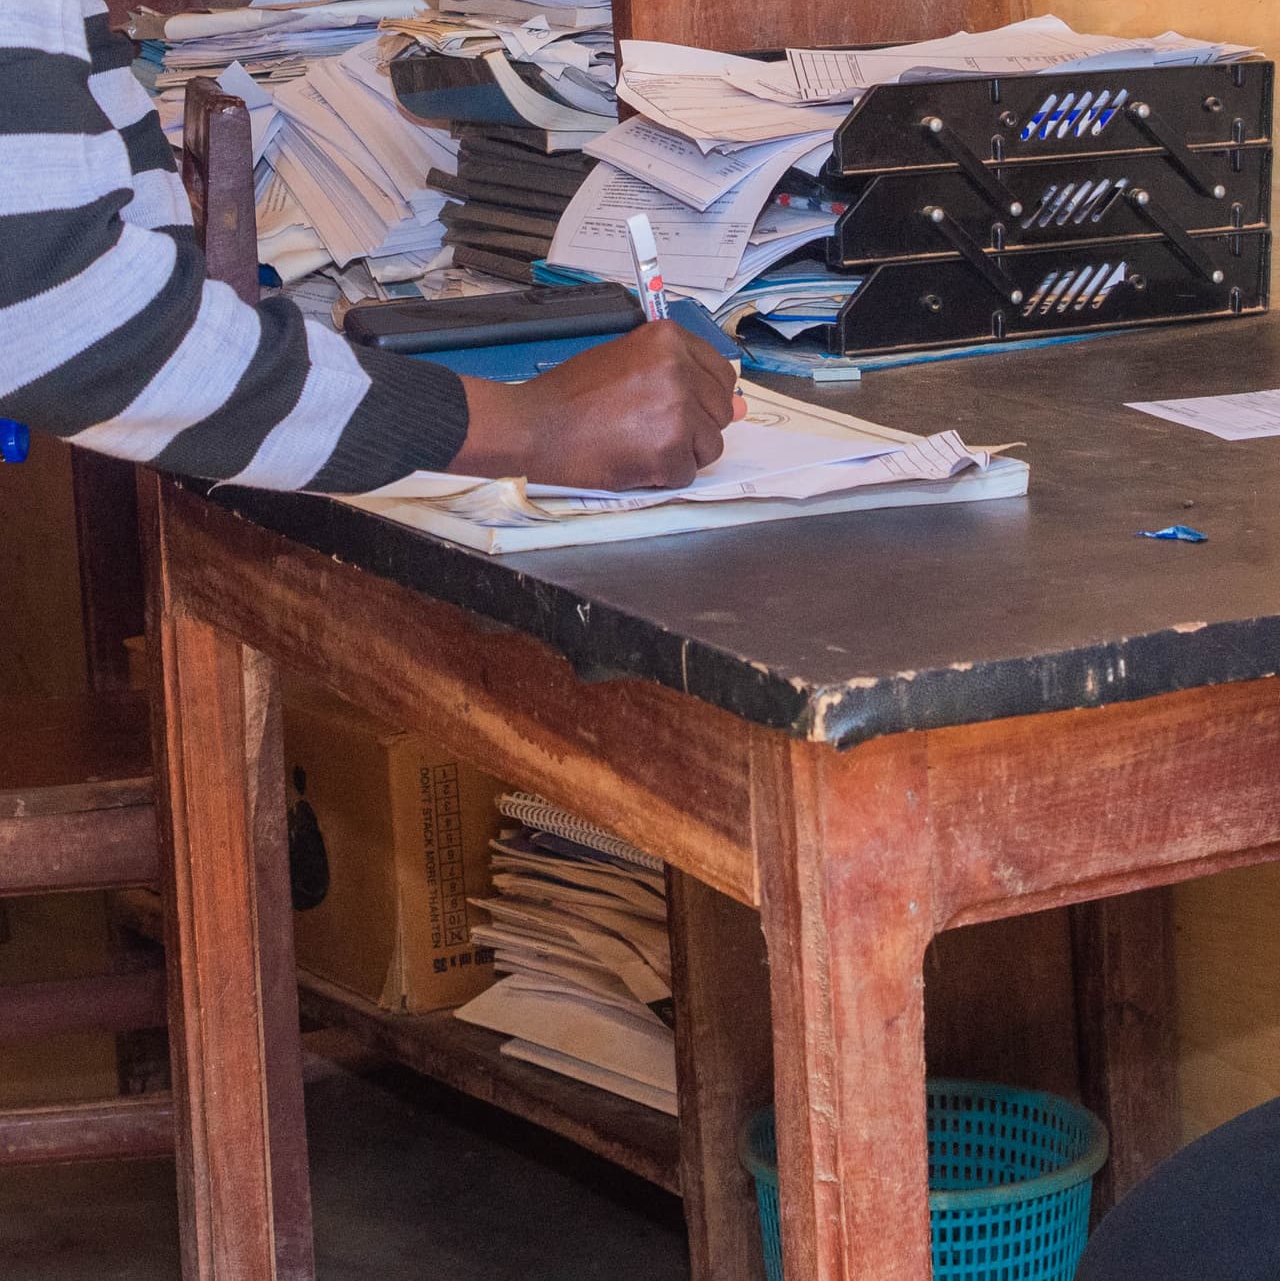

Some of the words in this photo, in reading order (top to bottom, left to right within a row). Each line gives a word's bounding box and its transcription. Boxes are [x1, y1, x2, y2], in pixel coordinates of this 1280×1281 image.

[422, 807, 436, 848] STACK
[424, 850, 439, 887] MORE
[428, 890, 440, 923] THAN
[430, 925, 442, 949] TEN
